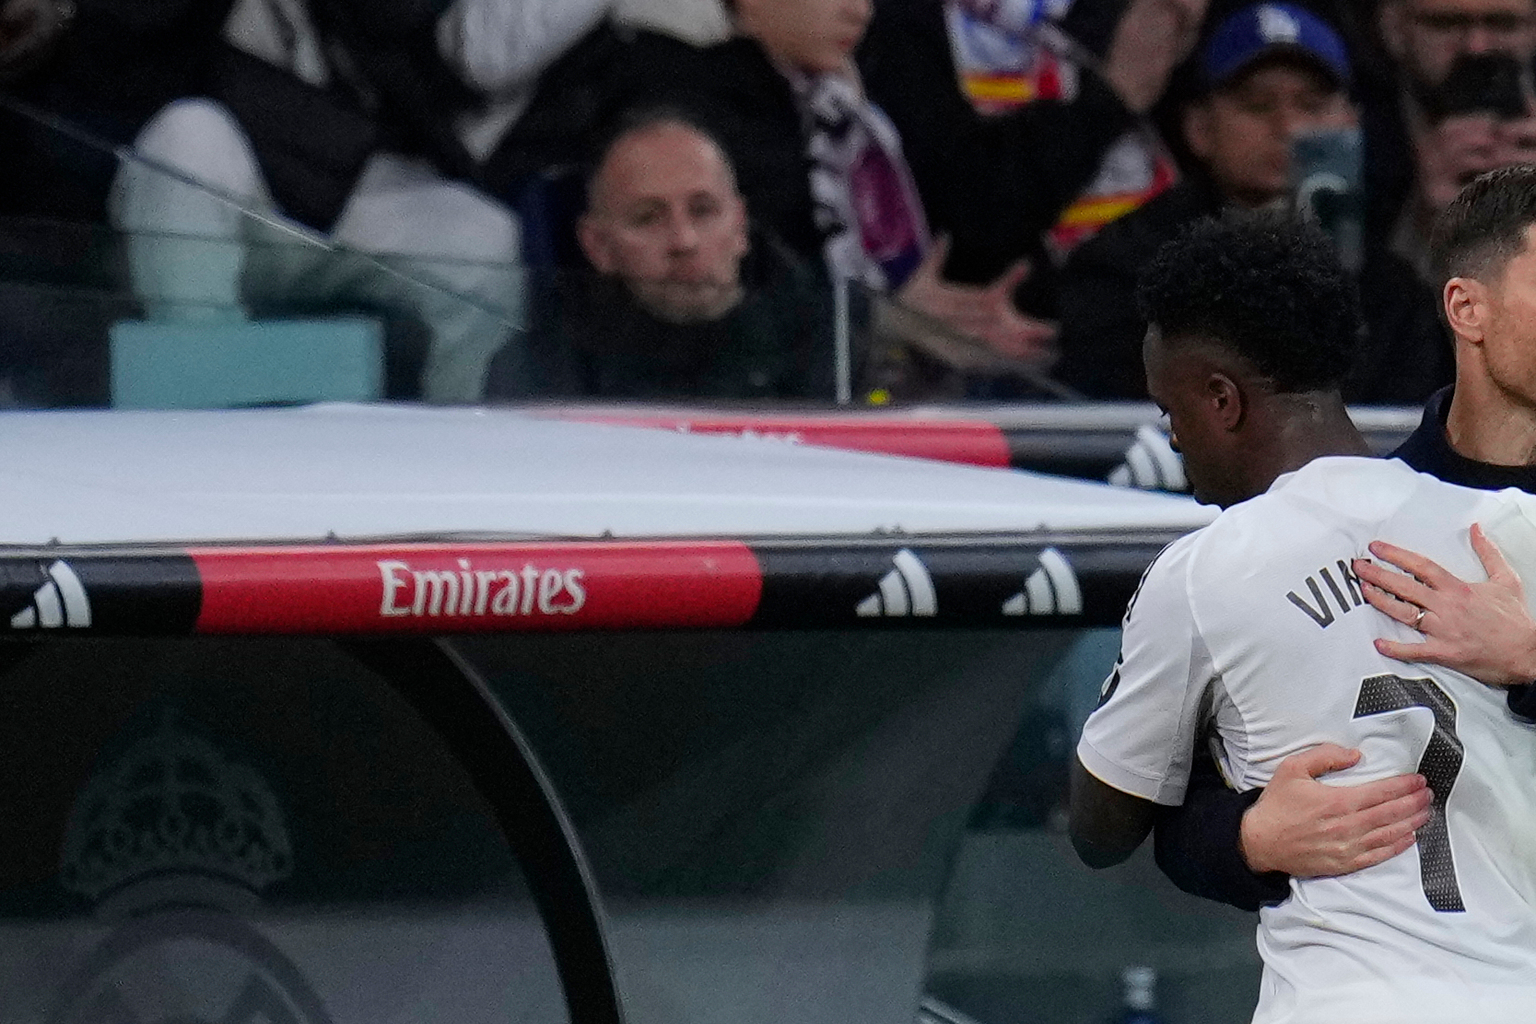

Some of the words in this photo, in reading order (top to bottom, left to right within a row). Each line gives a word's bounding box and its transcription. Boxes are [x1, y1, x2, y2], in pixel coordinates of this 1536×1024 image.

[377, 557, 586, 616] Emirates
[1286, 558, 1372, 629] VIN
[1352, 674, 1466, 913] 7
